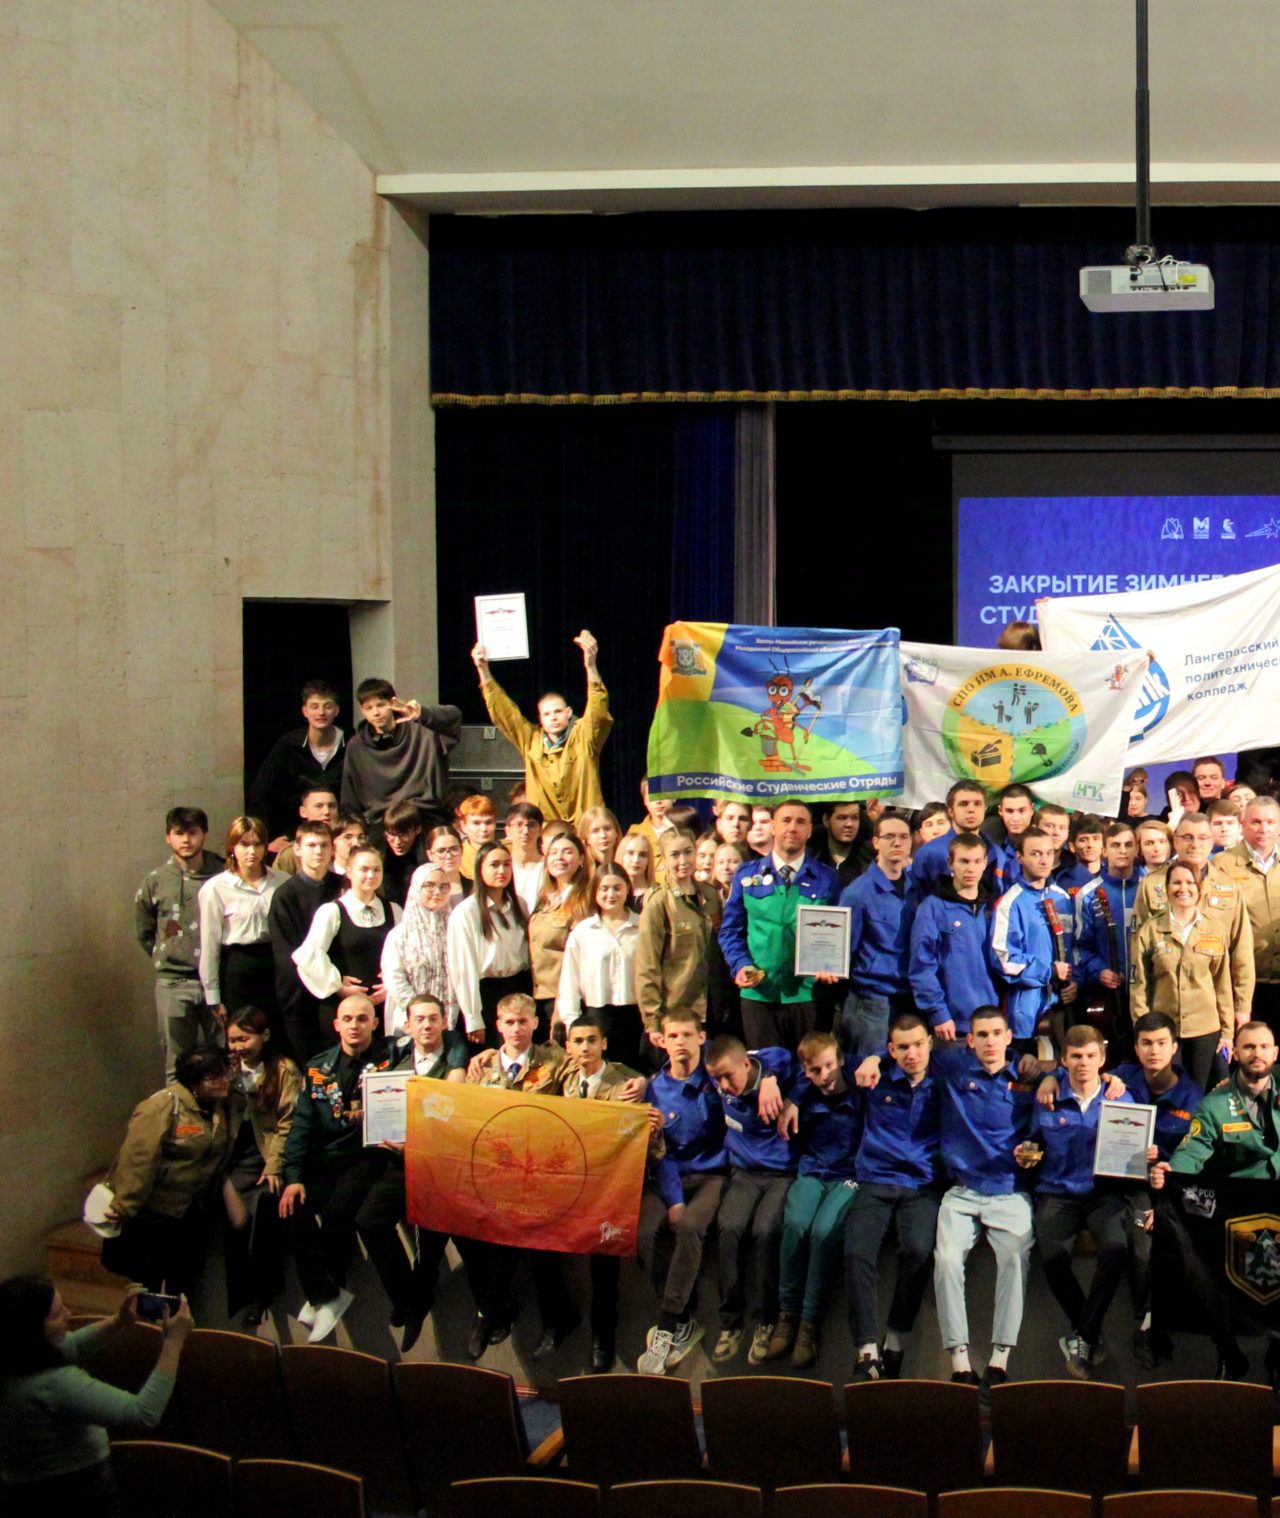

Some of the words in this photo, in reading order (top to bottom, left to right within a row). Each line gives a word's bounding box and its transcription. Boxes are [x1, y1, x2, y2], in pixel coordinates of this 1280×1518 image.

[989, 574, 1118, 593] ЗАКРЫТИЕ
[1184, 637, 1279, 666] Лангепасский
[953, 683, 975, 707] СПО
[975, 670, 996, 684] ИМ
[1000, 667, 1012, 677] А.
[1015, 667, 1078, 712] ЕФРЕМОВА
[1186, 681, 1247, 701] колледж
[677, 775, 754, 793] Российские
[756, 780, 847, 793] Студенческие
[848, 775, 897, 788] Отряды
[1199, 1188, 1215, 1199] РСО
